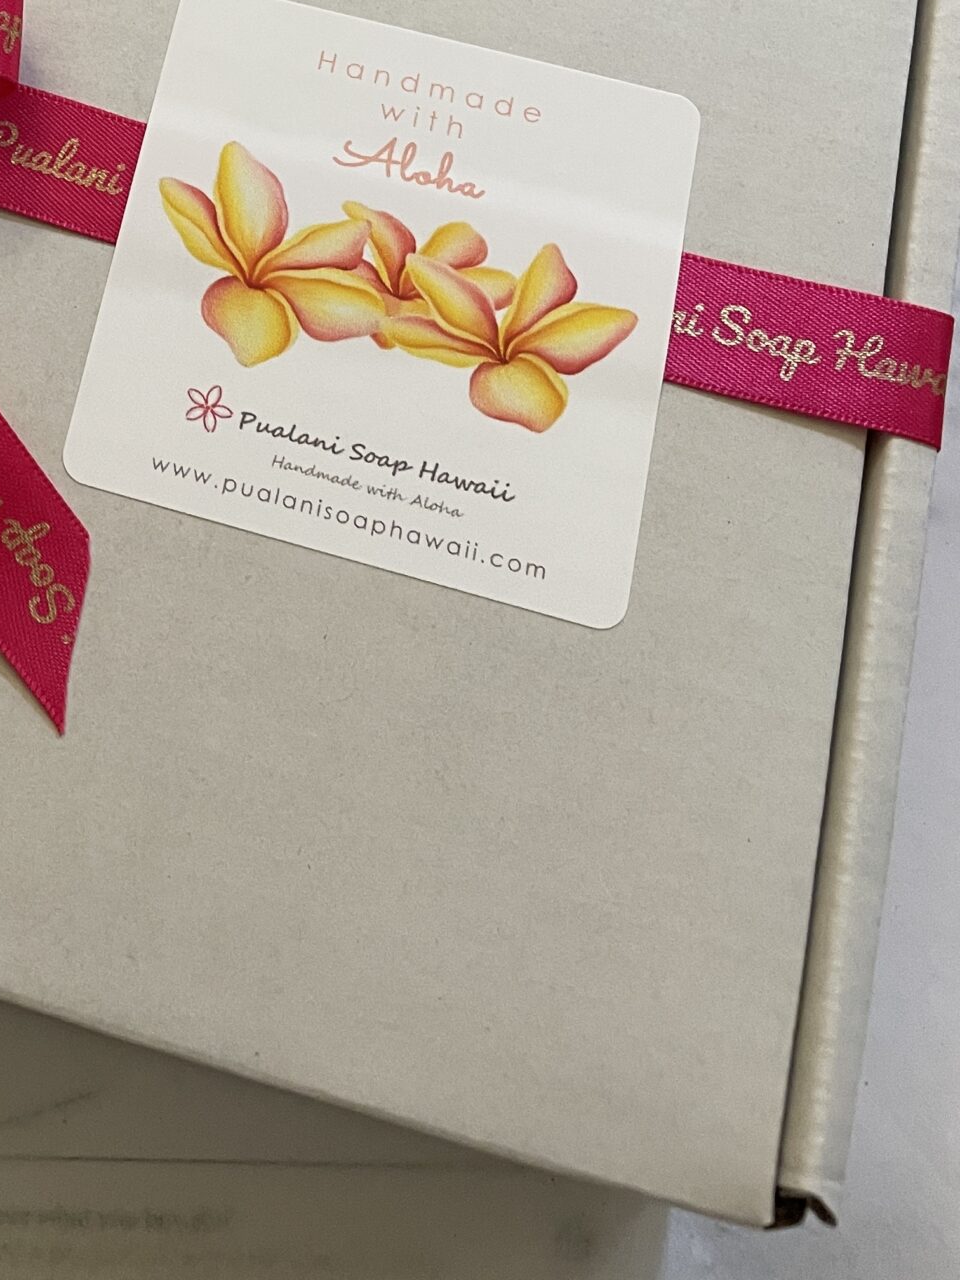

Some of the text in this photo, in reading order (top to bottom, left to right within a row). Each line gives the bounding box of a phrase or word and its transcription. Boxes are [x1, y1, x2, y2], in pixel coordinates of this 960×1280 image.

[317, 50, 542, 124] Handmade
[381, 103, 464, 139] with
[332, 137, 486, 200] Aloha
[712, 305, 822, 382] Soap
[238, 411, 516, 503] Pualani Soap Hawaii
[271, 454, 465, 519] Handmade with Aloha
[151, 457, 548, 581] www.pualanisoaphawaii.com
[1, 519, 76, 624] Soap
